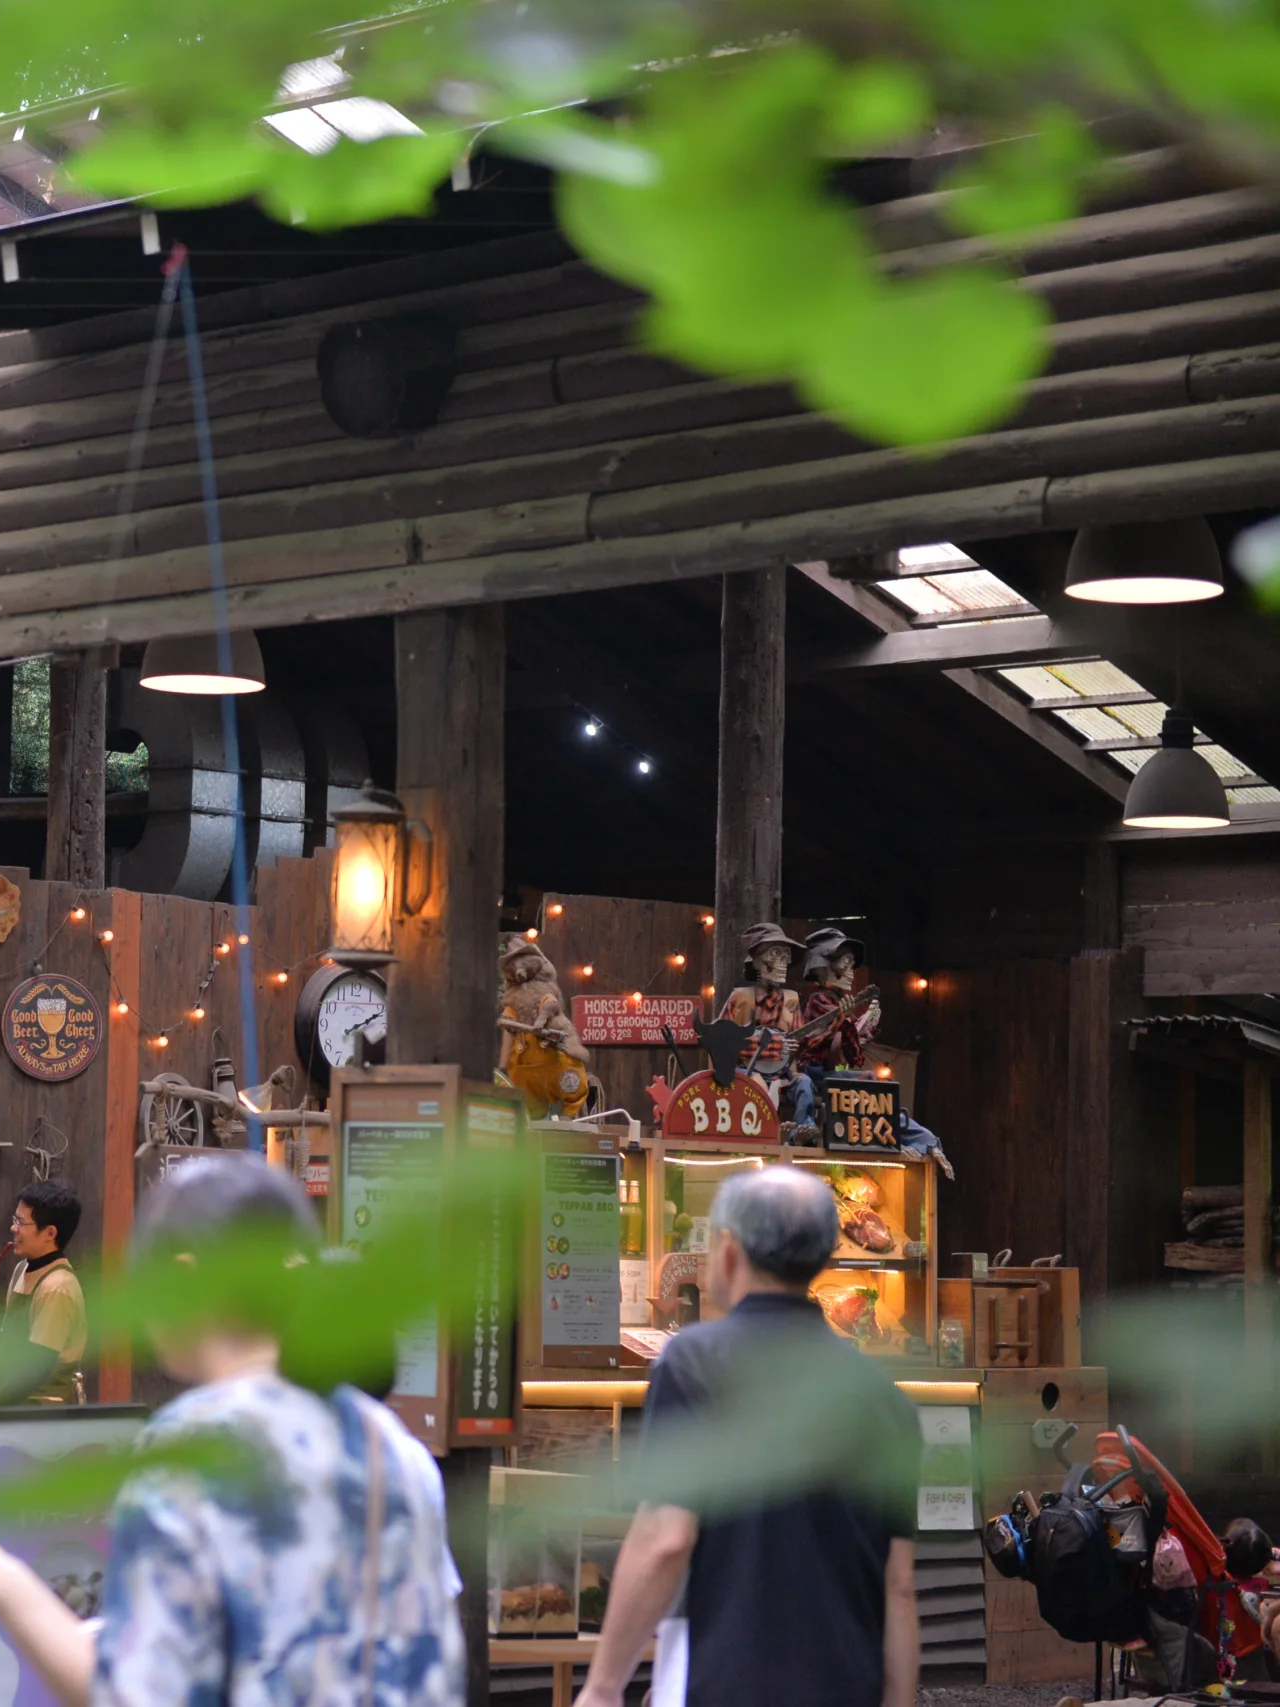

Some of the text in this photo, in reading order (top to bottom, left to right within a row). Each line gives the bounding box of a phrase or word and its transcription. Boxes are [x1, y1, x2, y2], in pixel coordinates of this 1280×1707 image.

[336, 987, 346, 1001] 11
[350, 983, 362, 997] 12
[325, 1001, 337, 1014] 10
[584, 1000, 694, 1016] HORSES BOARDED
[11, 1009, 37, 1023] Good
[68, 1009, 94, 1023] Good
[587, 1016, 604, 1028] FED
[606, 1016, 615, 1028] &
[617, 1016, 660, 1028] GROOMED
[320, 1019, 328, 1033] 9
[582, 1028, 607, 1041] SHOD
[324, 1038, 332, 1053] 8
[16, 1044, 46, 1072] ALWAYS
[52, 1062, 68, 1073] TAP
[67, 1045, 90, 1069] HERE
[335, 1051, 343, 1066] 7
[828, 1087, 893, 1116] TEPPAN
[689, 1097, 762, 1135] BBQ
[847, 1116, 897, 1146] BBQ
